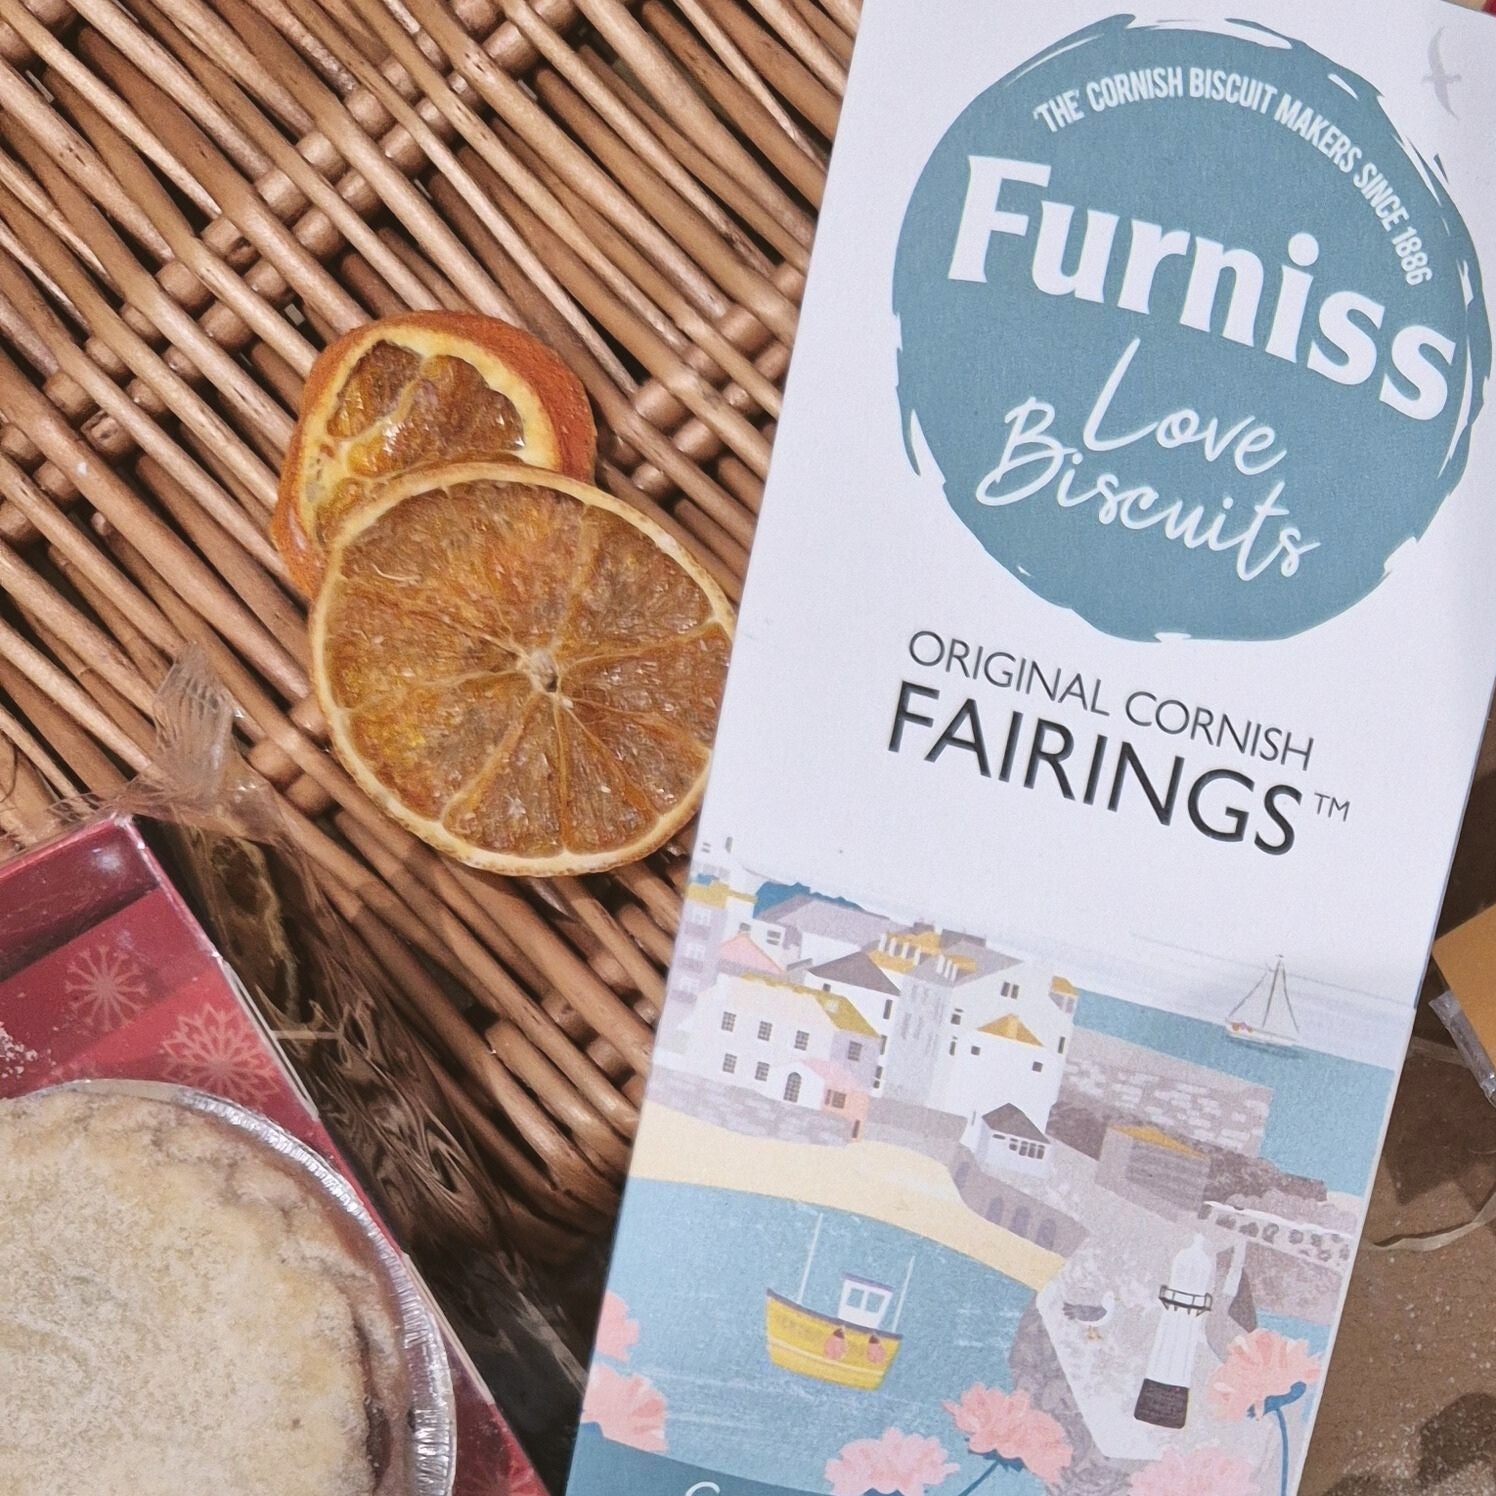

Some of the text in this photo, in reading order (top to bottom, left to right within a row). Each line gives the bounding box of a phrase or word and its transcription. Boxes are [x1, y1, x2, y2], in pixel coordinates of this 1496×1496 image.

[1086, 66, 1183, 112] CORNISH
[1189, 67, 1278, 114] BISCUIT
[1274, 94, 1362, 173] MAKERS
[1353, 162, 1410, 232] SINCE
[1391, 226, 1433, 286] 1886
[947, 155, 1457, 420] Furniss
[975, 397, 1320, 581] Biscuits
[1082, 337, 1286, 477] Love
[908, 630, 1314, 771] ORIGINAL CORNISH
